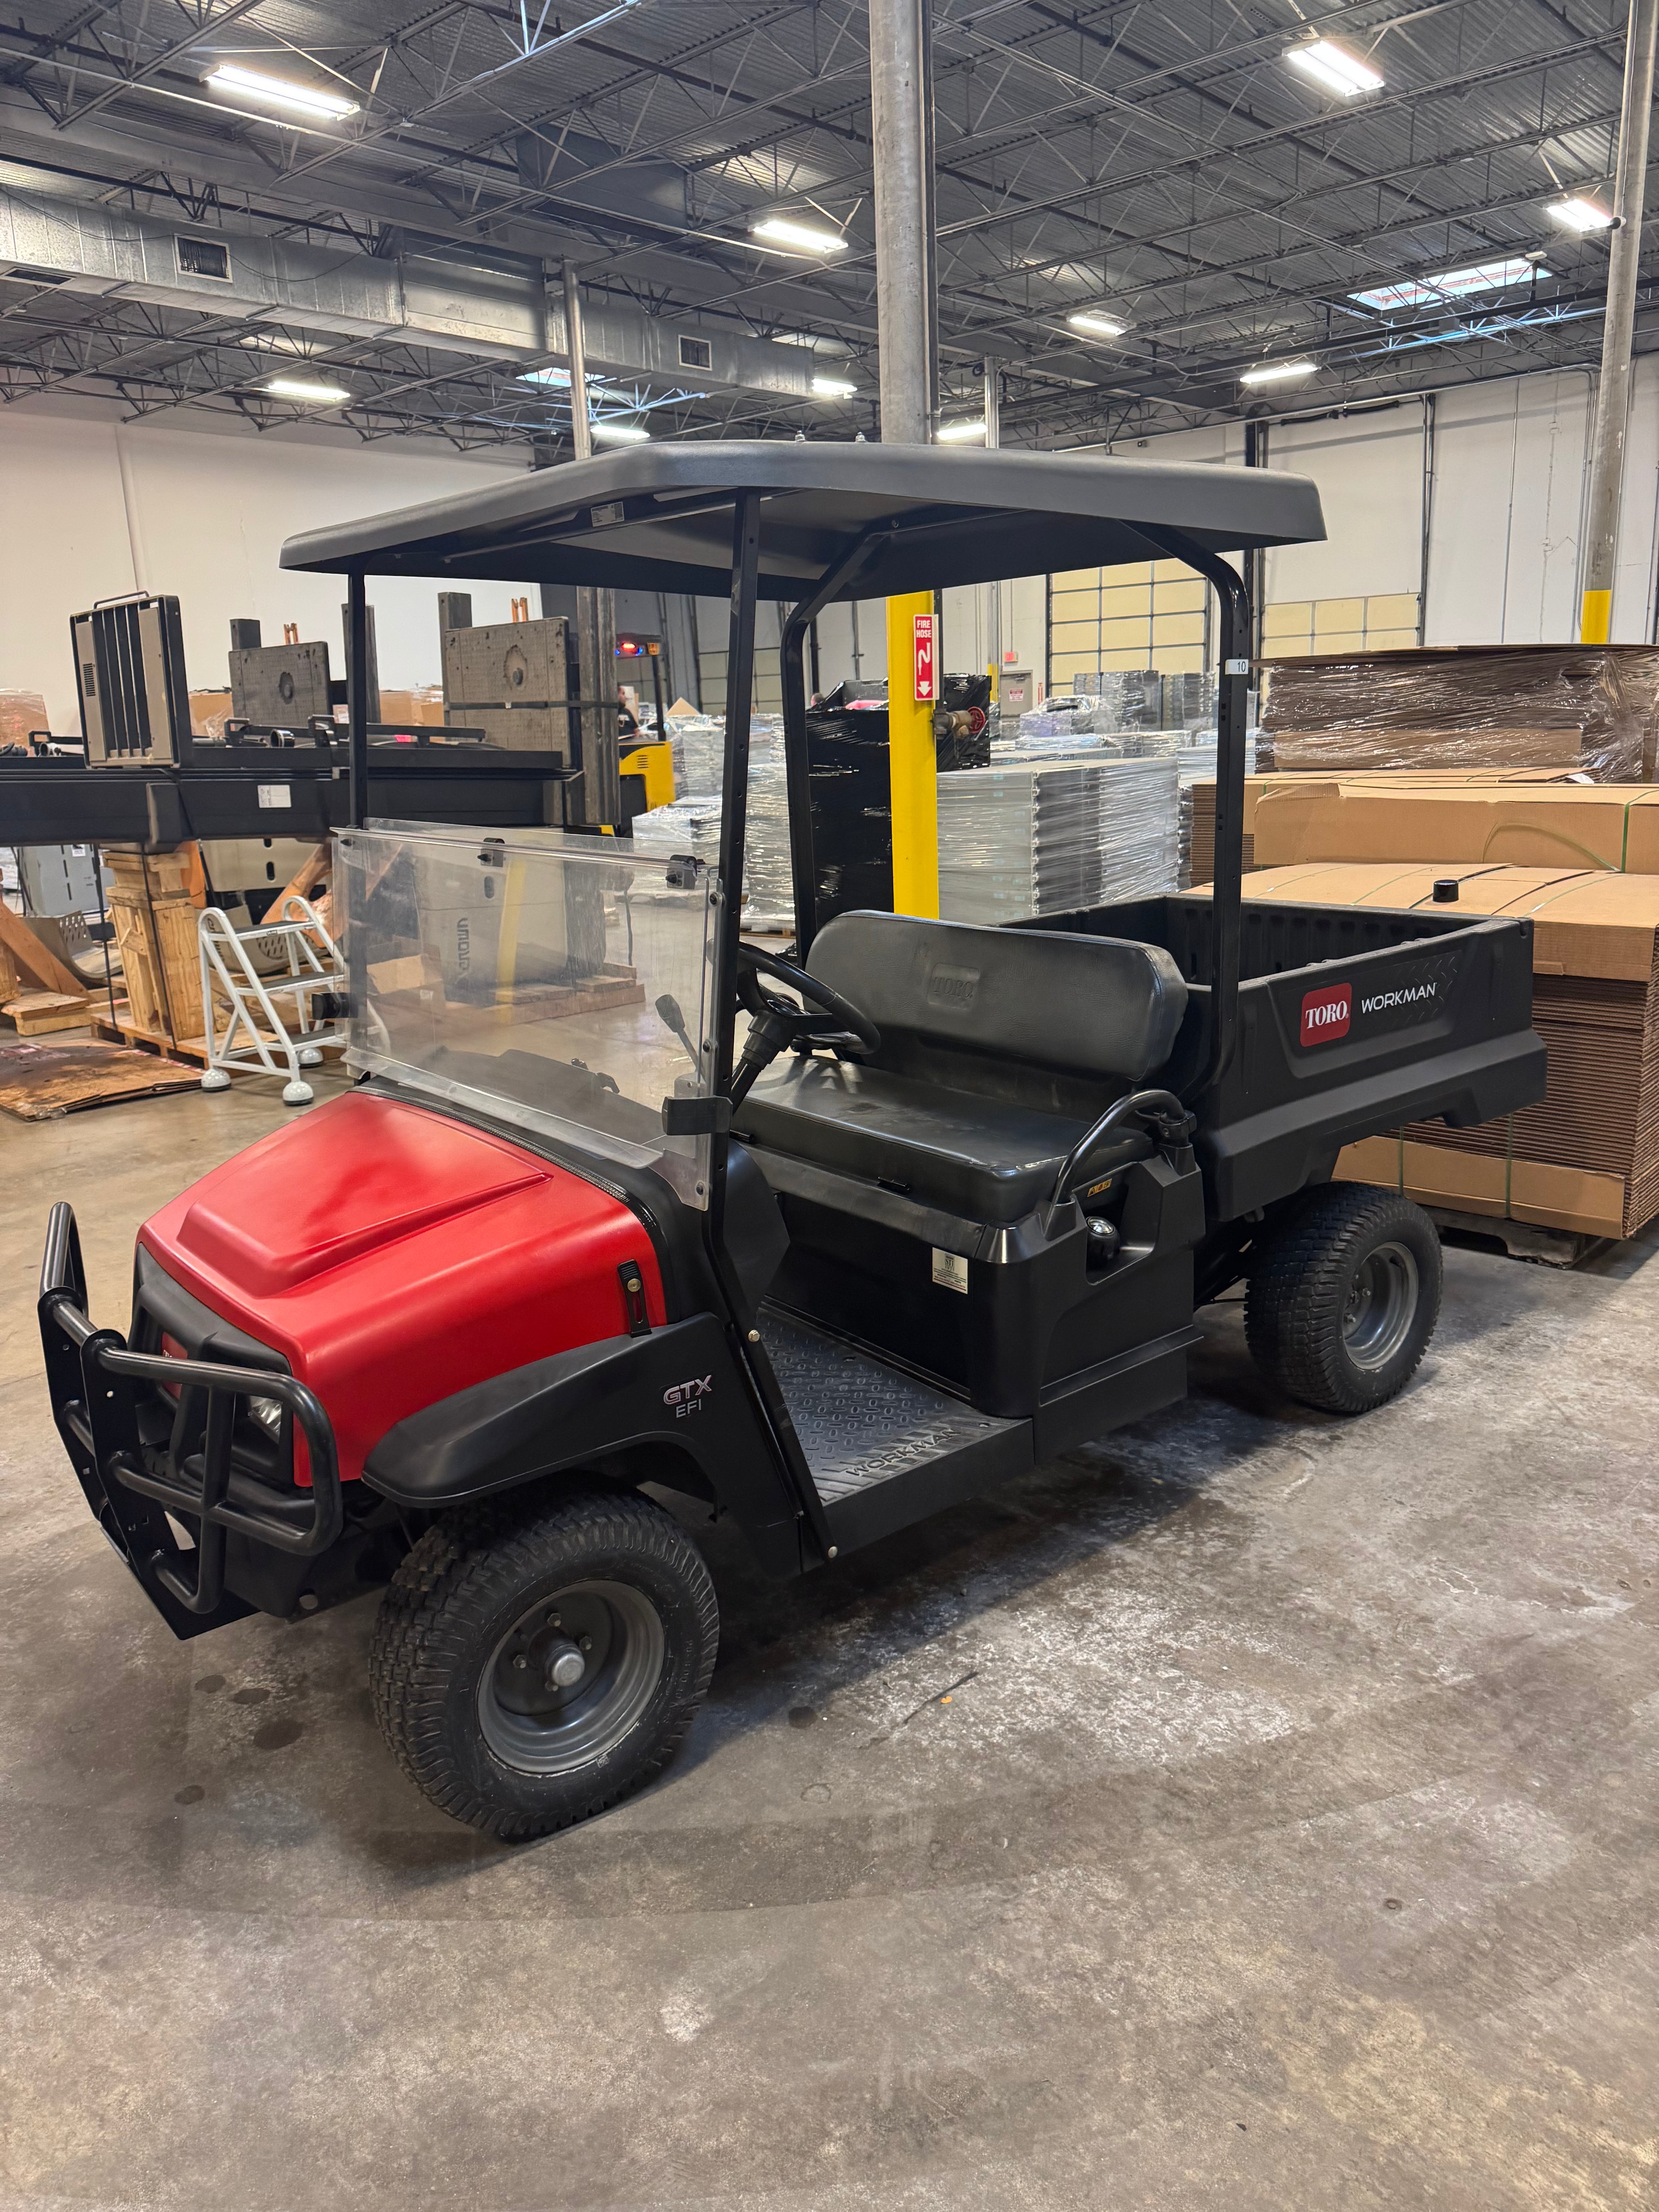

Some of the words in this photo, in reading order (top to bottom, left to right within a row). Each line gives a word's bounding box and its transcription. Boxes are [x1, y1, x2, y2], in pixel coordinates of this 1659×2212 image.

[916, 629, 932, 638] HOSE
[917, 620, 931, 629] FIRE
[1237, 661, 1246, 672] 10
[933, 977, 973, 998] TORO
[1305, 1000, 1348, 1029] TORO
[1361, 982, 1437, 1014] WORKMAN
[663, 1375, 712, 1405] GTX
[676, 1398, 702, 1418] EFI
[845, 1427, 962, 1477] WORKMAN
